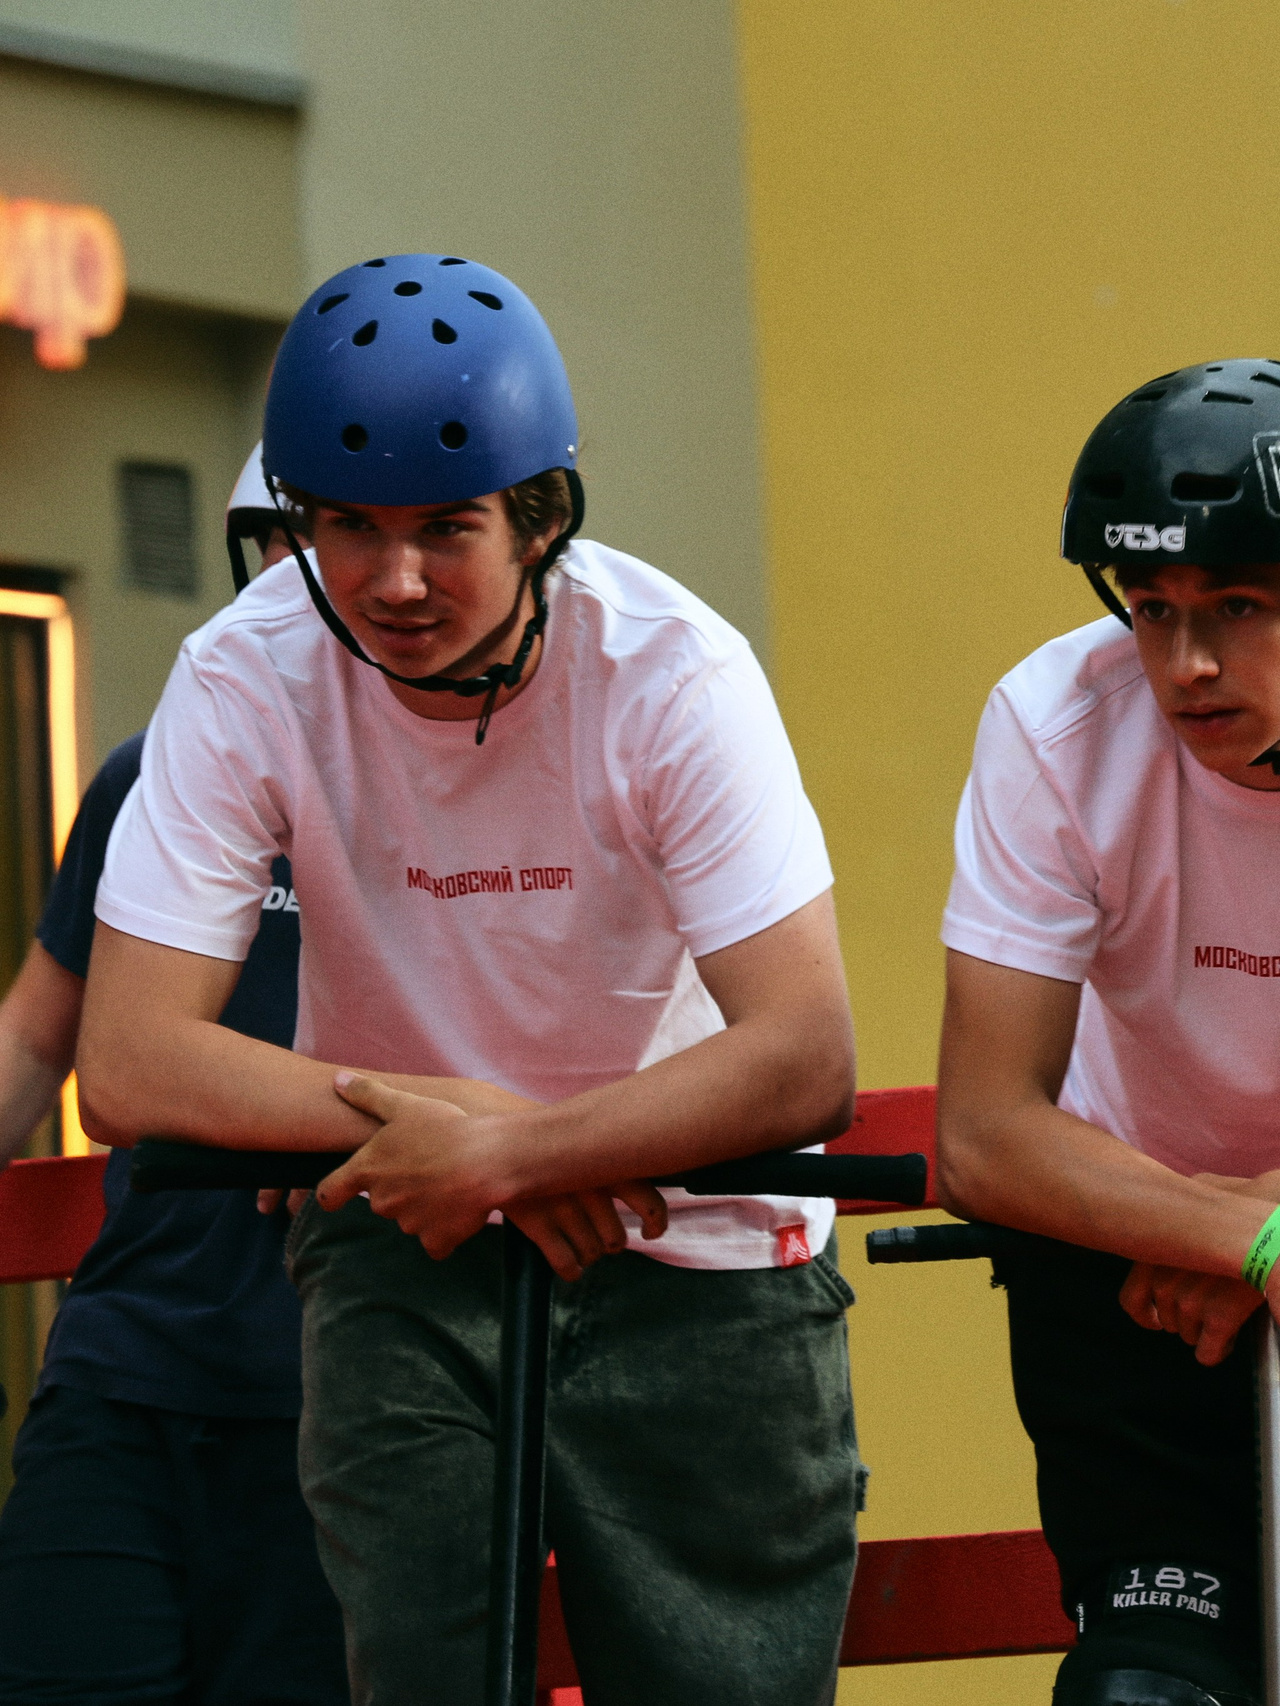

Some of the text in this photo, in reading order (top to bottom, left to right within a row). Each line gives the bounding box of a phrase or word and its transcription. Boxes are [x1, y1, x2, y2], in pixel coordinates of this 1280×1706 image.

[407, 866, 572, 899] МОКОВСКИЙ СПОРТ
[1124, 1567, 1221, 1596] 187
[1113, 1591, 1221, 1619] KILLER PADS
